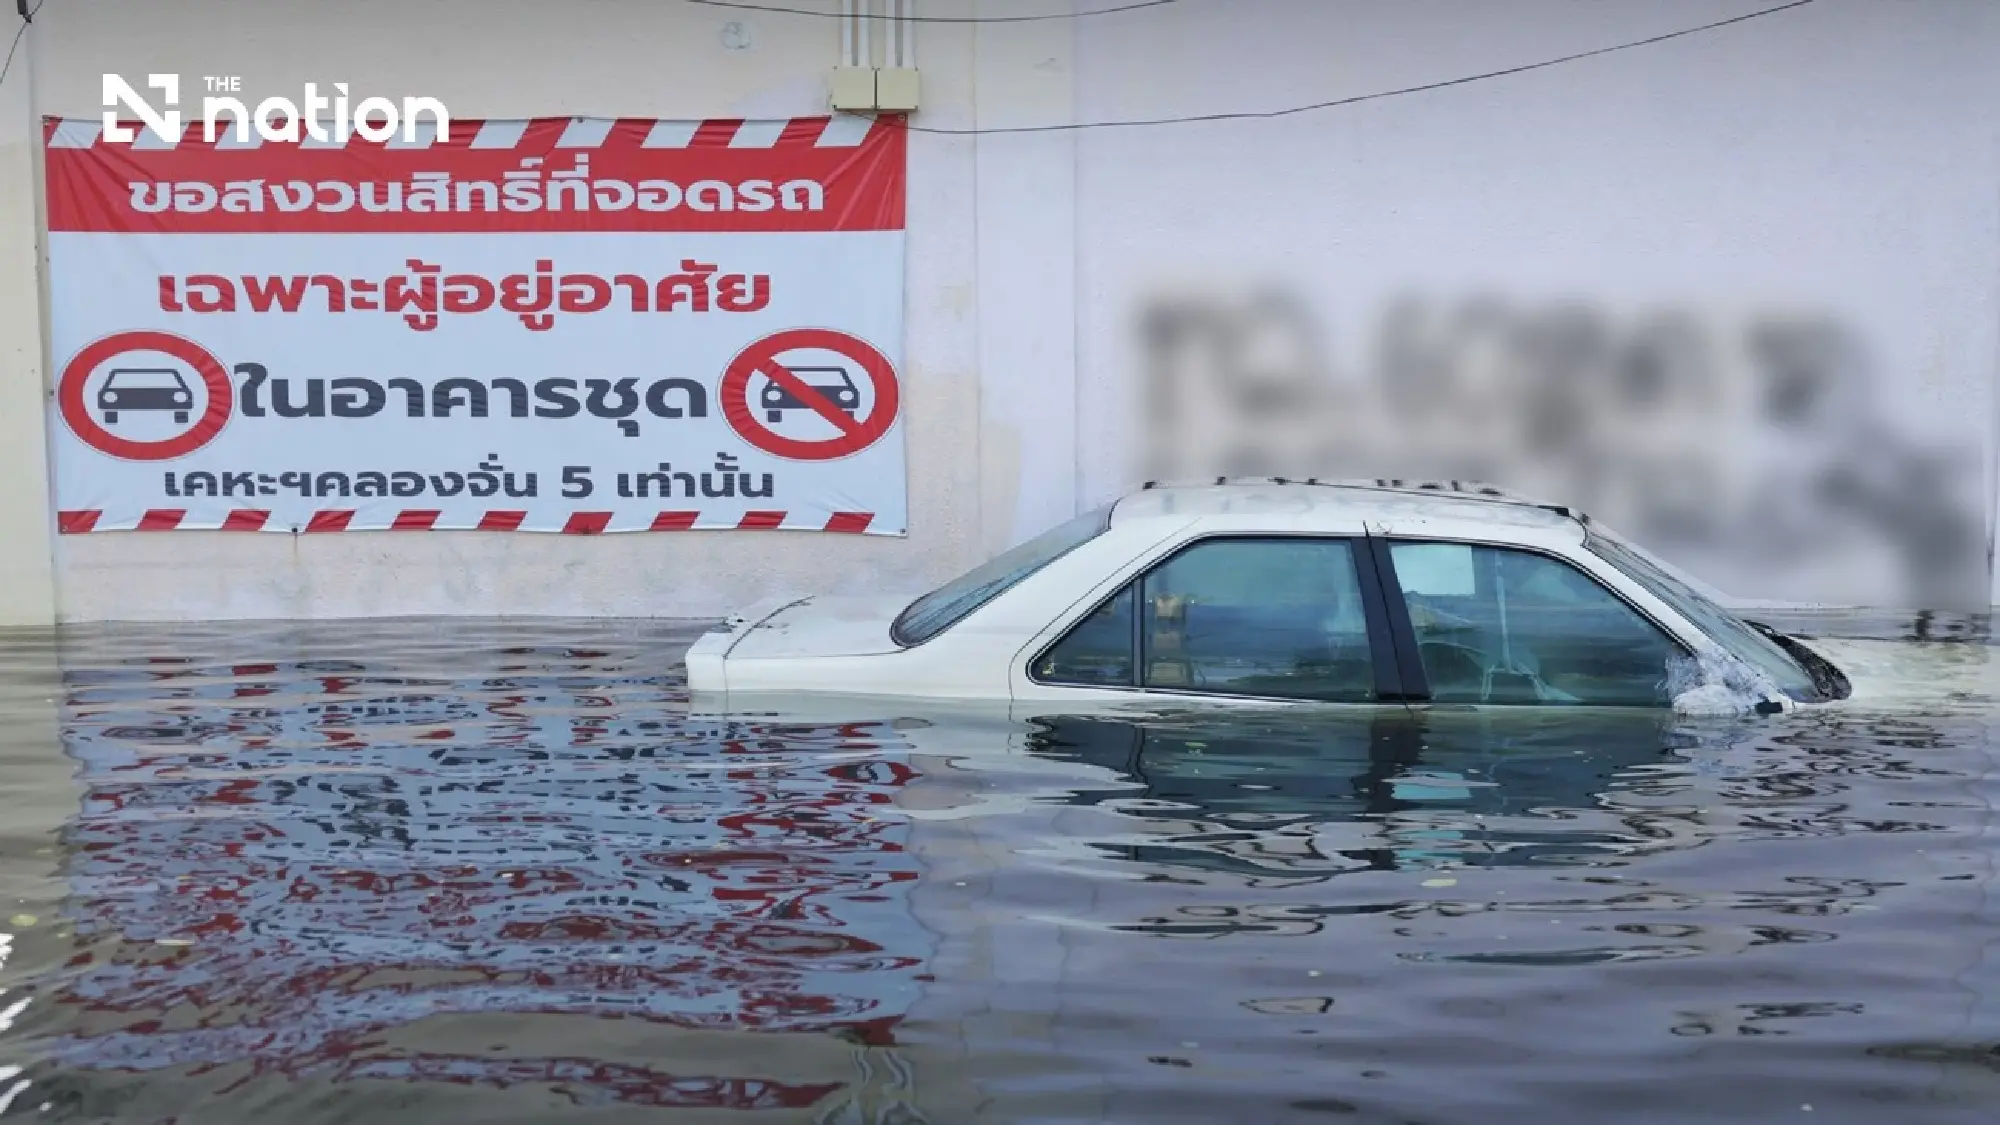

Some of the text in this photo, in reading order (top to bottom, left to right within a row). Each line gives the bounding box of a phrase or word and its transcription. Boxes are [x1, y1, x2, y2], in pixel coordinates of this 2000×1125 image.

[128, 154, 824, 213] ขอสงวนสิทธิ์ที่จอดรถ
[158, 259, 771, 331] เฉพาะผู้อยู่อาศัย
[233, 362, 707, 437] ในอาคารชุด
[164, 452, 774, 499] เคหะฯคลองจั่น 5 เท่านั้น
